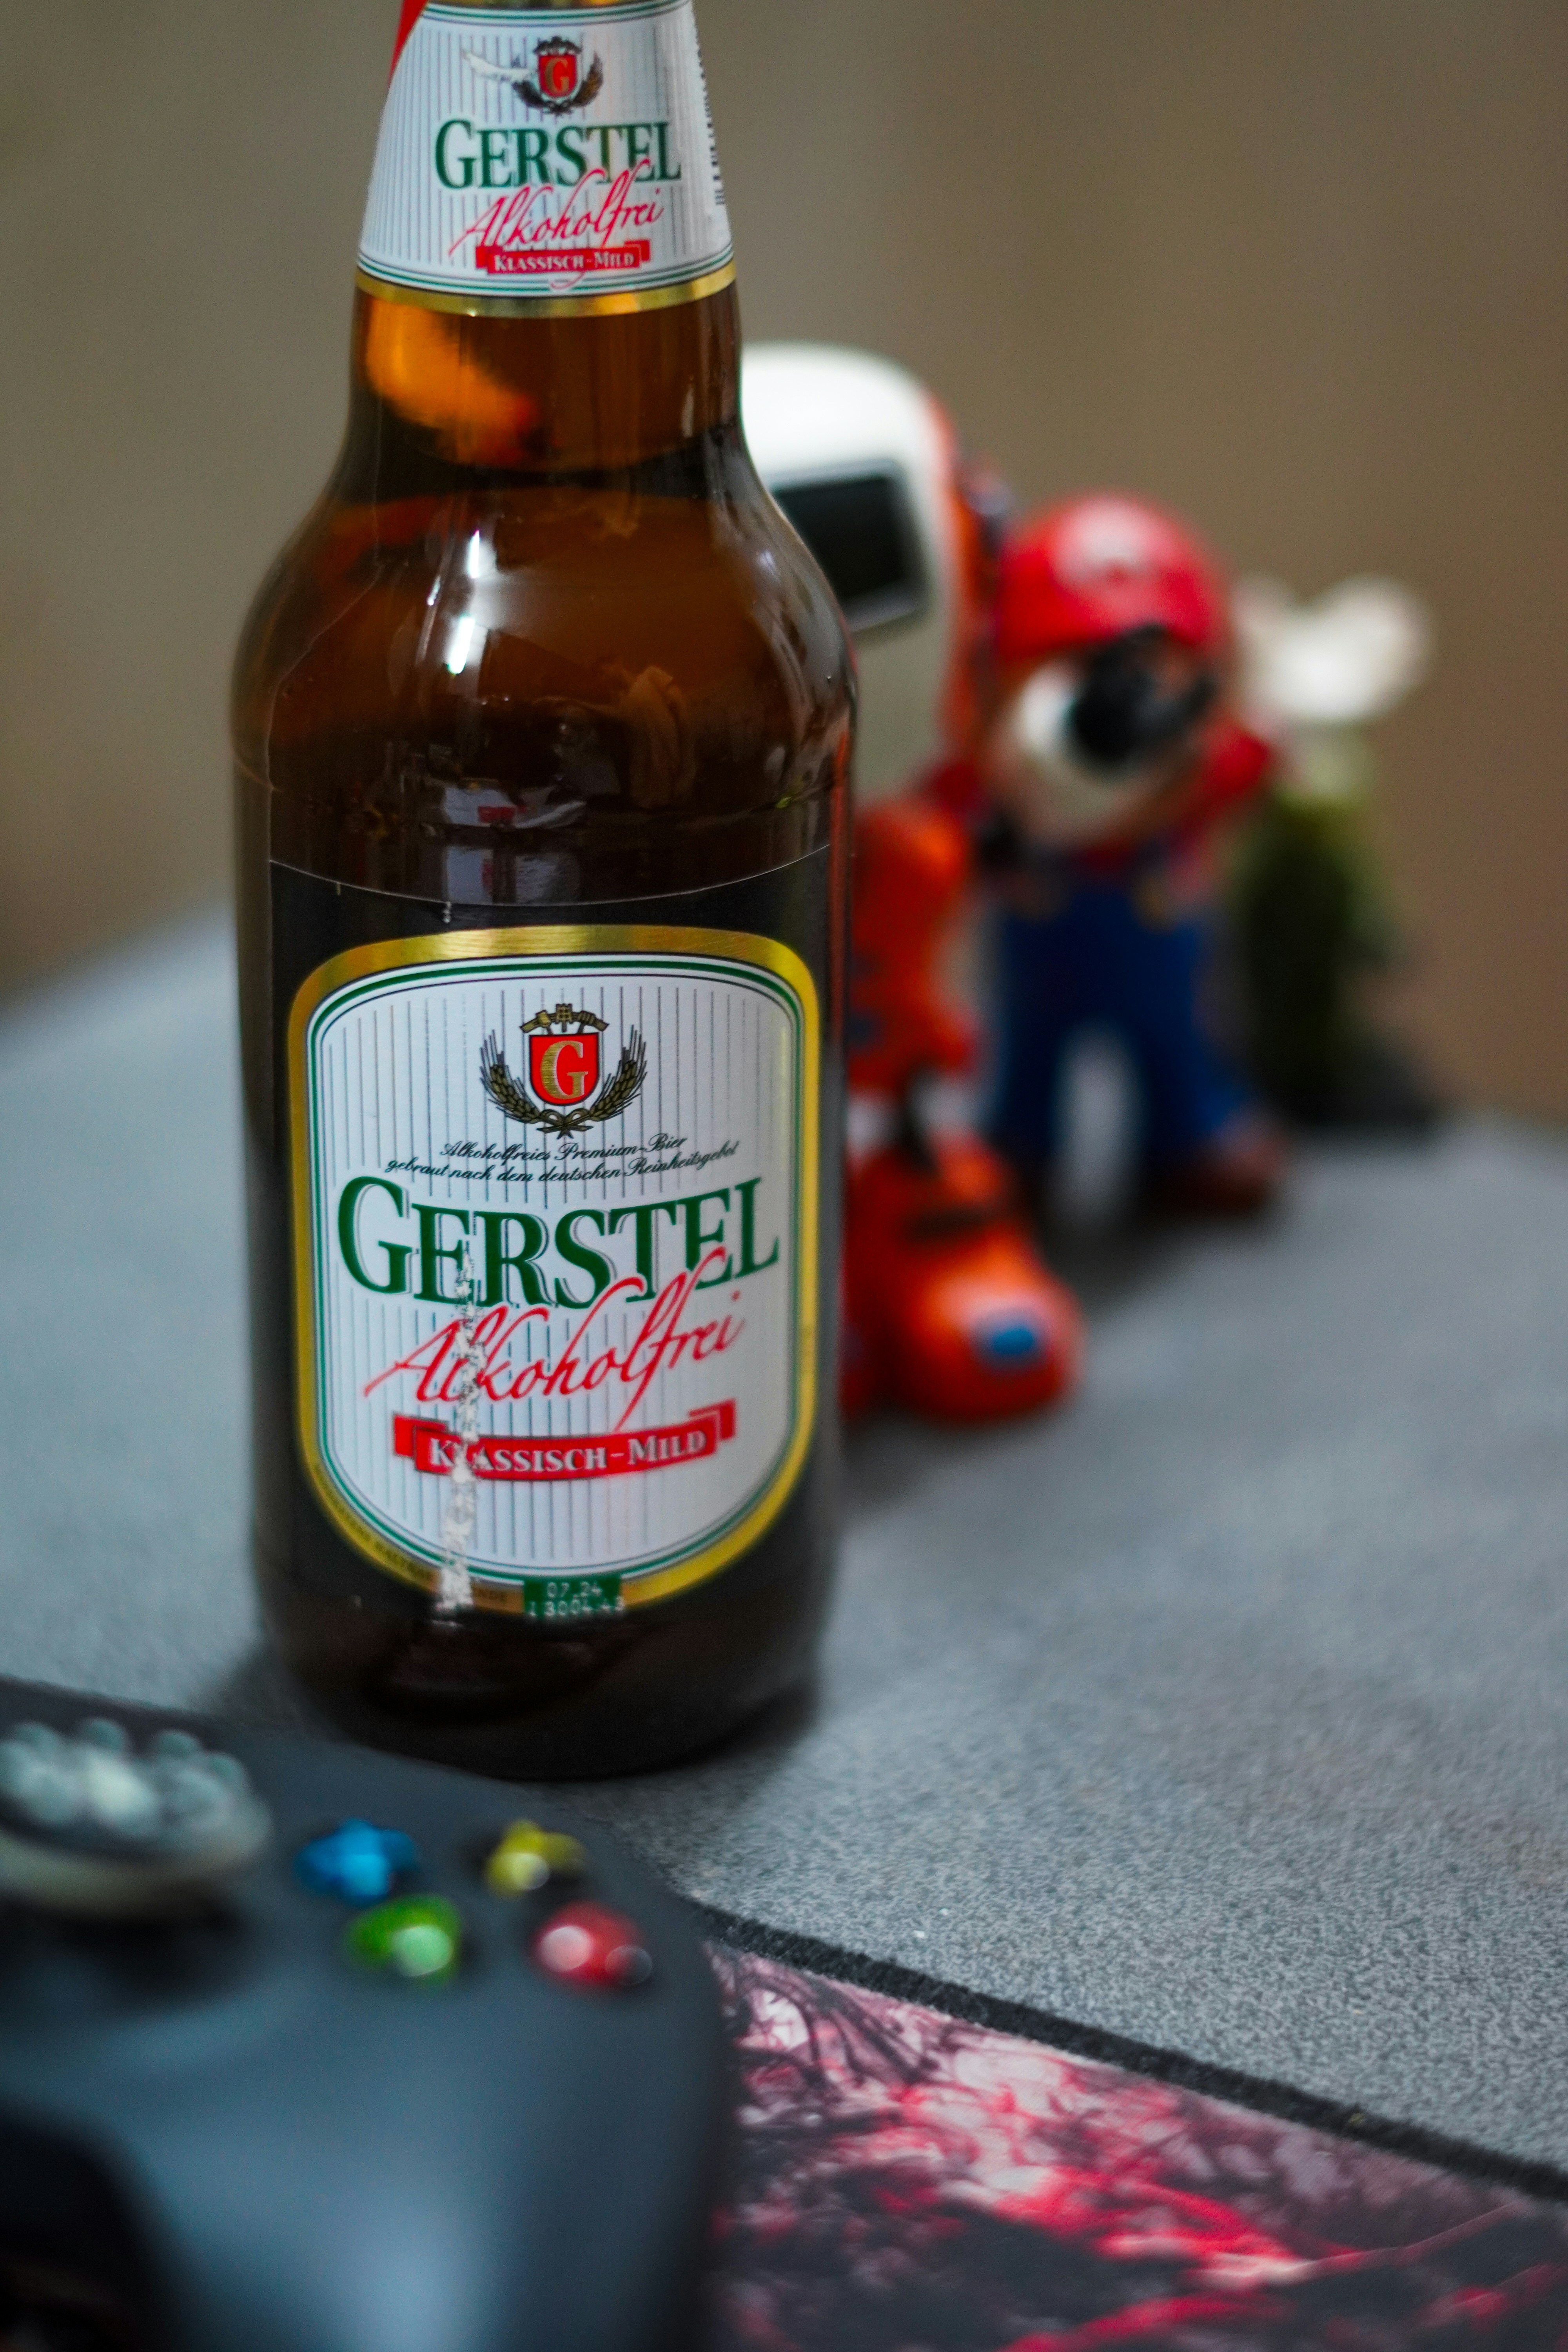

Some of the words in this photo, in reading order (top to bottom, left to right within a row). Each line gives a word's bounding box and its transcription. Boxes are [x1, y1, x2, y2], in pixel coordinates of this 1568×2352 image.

[435, 119, 681, 189] GERSTEL
[448, 158, 664, 289] Alkoholfrei
[539, 1040, 589, 1099] G
[384, 1156, 450, 1177] gebraut
[448, 1164, 496, 1181] nach
[496, 1166, 534, 1182] dem
[538, 1162, 626, 1182] deutschen
[624, 1139, 740, 1176] Reinheitsgebot
[439, 1140, 551, 1166] Alkoholfreies
[554, 1132, 688, 1161] Premium-Bier
[338, 1175, 779, 1310] GERSTEL
[364, 1245, 746, 1433] Alkoholfrei
[428, 1430, 706, 1473] KASSISCH-MILD
